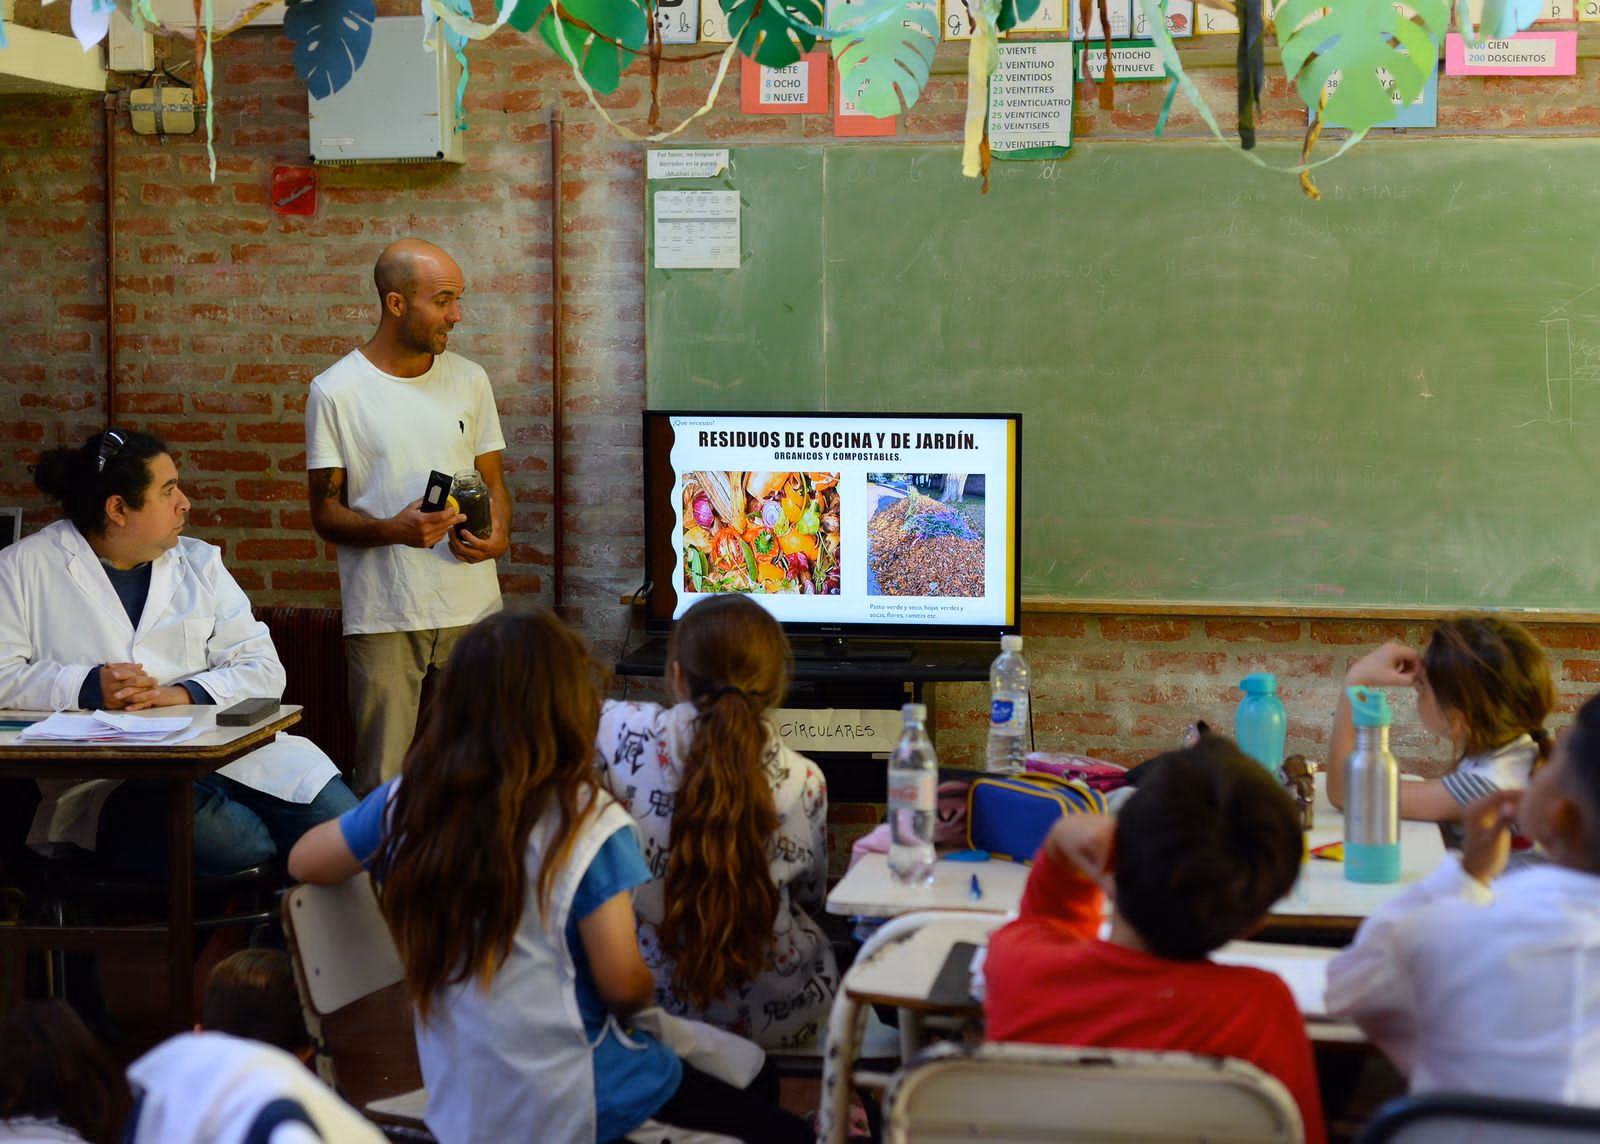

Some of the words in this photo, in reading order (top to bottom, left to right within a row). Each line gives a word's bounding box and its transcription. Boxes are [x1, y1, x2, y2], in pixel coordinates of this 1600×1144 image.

[1487, 41, 1509, 50] CIEN
[1006, 46, 1038, 55] VIENTE
[1096, 51, 1152, 60] VENTIOCHO
[1468, 54, 1486, 62] 200
[1487, 54, 1547, 63] DOSCIENTOS
[1006, 60, 1055, 70] VEINTIUNO
[1006, 73, 1053, 82] VEINTIDOS
[773, 79, 801, 88] OCHO
[1006, 86, 1055, 95] VEINTITRES
[773, 92, 805, 102] NUEVE
[1006, 98, 1071, 108] VEINTICUATRO
[1005, 111, 1060, 119] VEINTICINCO
[1004, 122, 1050, 130] VEINTISEIS
[1005, 140, 1057, 149] VEINTISIETE
[698, 431, 780, 448] RESIDUOS
[785, 431, 804, 448] DE
[809, 431, 872, 449] COCINA
[876, 432, 886, 449] Y
[891, 432, 911, 449] DE
[915, 430, 979, 450] JARDÍN.
[774, 451, 824, 460] ORGANICOS
[826, 452, 830, 461] Y
[832, 452, 902, 462] COMPOSTABLES.
[779, 721, 876, 740] CIRCULARES
